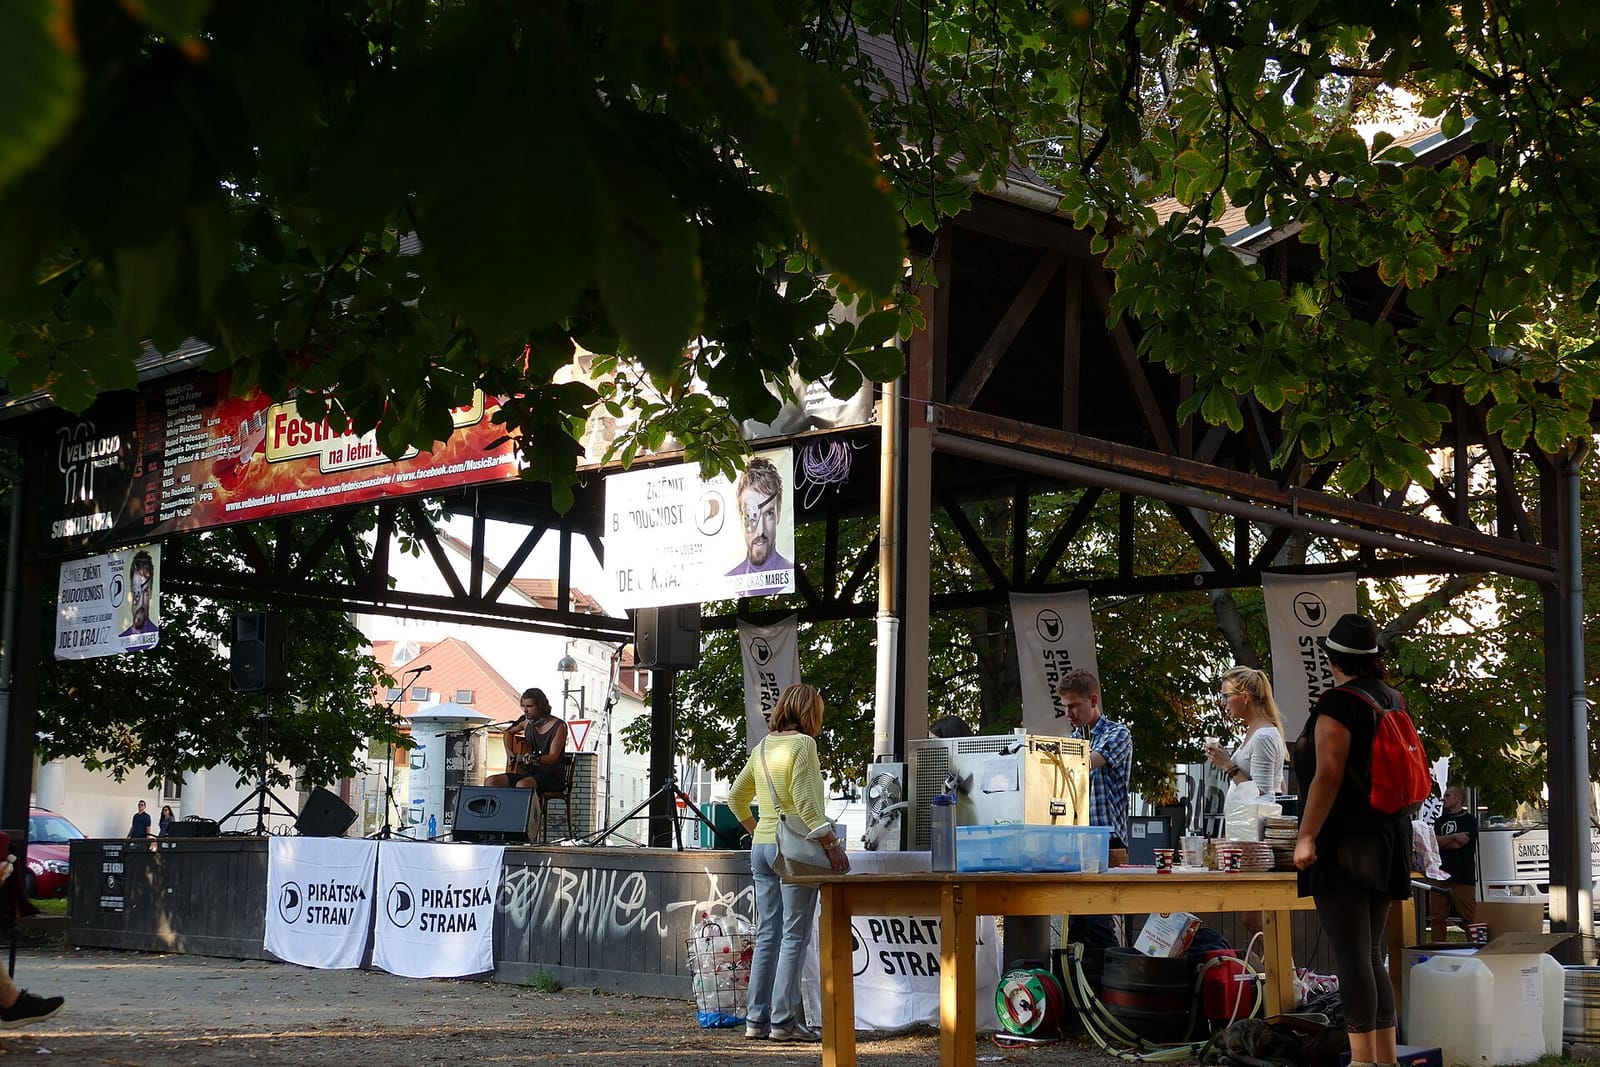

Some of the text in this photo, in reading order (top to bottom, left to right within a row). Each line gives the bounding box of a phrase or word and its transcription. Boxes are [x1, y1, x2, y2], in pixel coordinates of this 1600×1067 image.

[179, 432, 209, 444] Professors
[66, 435, 120, 463] VELBLOUD
[328, 450, 343, 465] na
[346, 440, 373, 463] letní
[765, 571, 789, 585] MAREŠ
[61, 584, 105, 605] BUDOUCNOST
[1518, 842, 1541, 857] ŠANCE
[421, 880, 492, 909] PIRÁTSKÁ
[419, 912, 478, 933] STRANA
[879, 951, 940, 977] STRA
